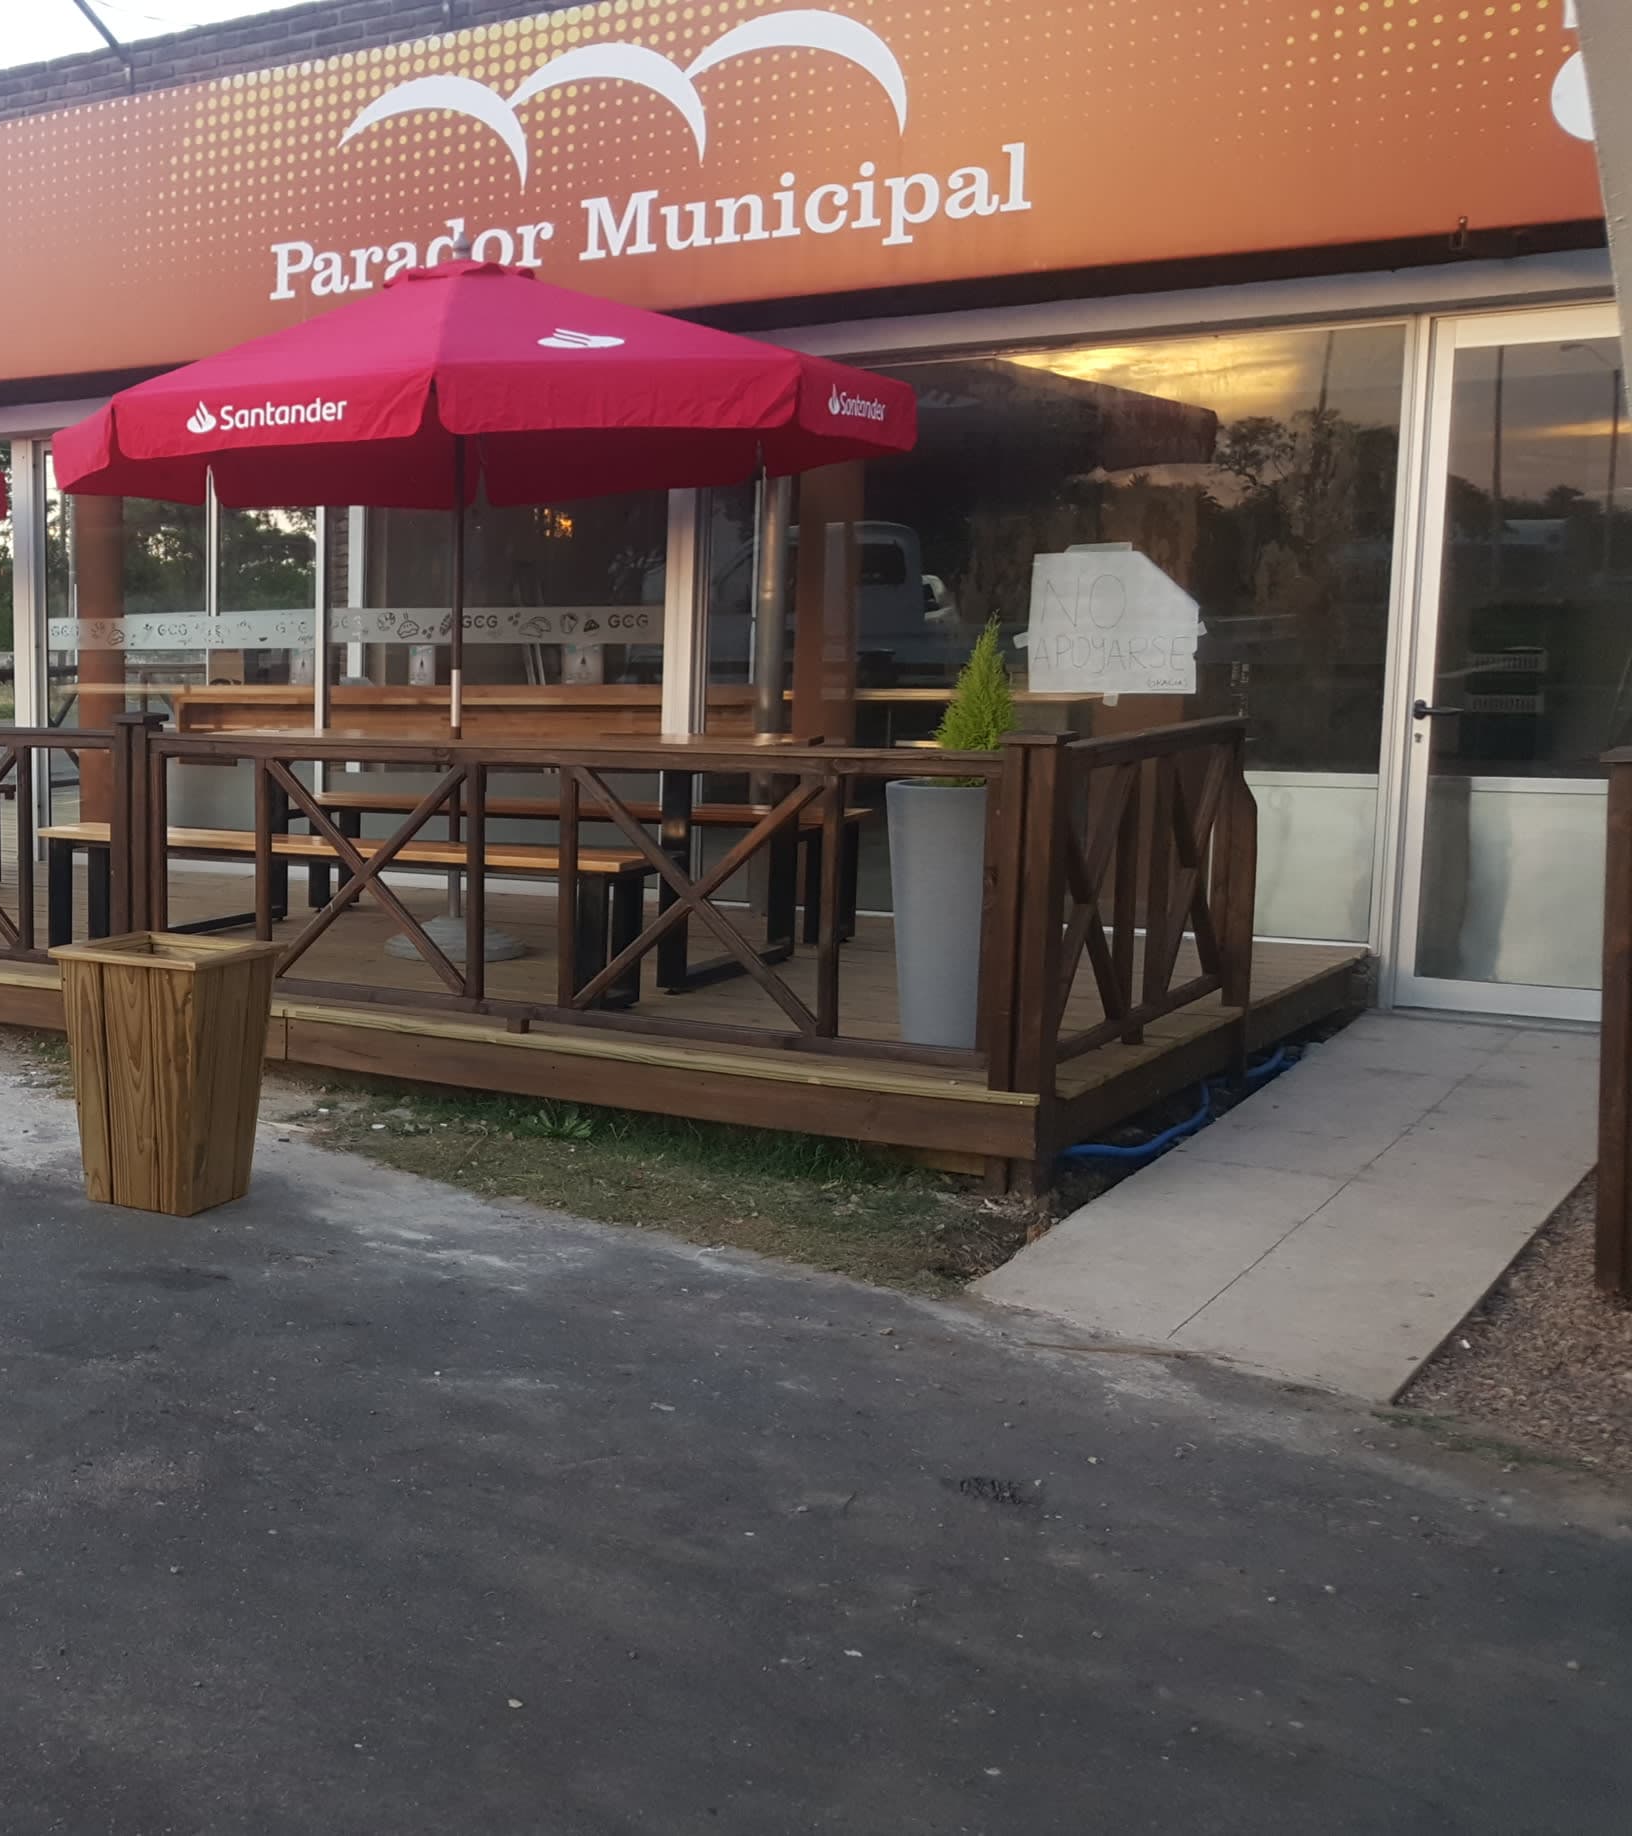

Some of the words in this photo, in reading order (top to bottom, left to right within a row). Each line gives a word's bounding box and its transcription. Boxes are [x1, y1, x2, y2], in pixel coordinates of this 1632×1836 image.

[269, 217, 555, 300] Parador
[579, 141, 1032, 261] Municipal
[219, 397, 347, 430] Santander
[840, 391, 886, 421] Santander
[1041, 574, 1127, 630] NO
[461, 614, 498, 629] GCG
[608, 614, 649, 629] GCG
[1033, 633, 1193, 674] APOYARSE
